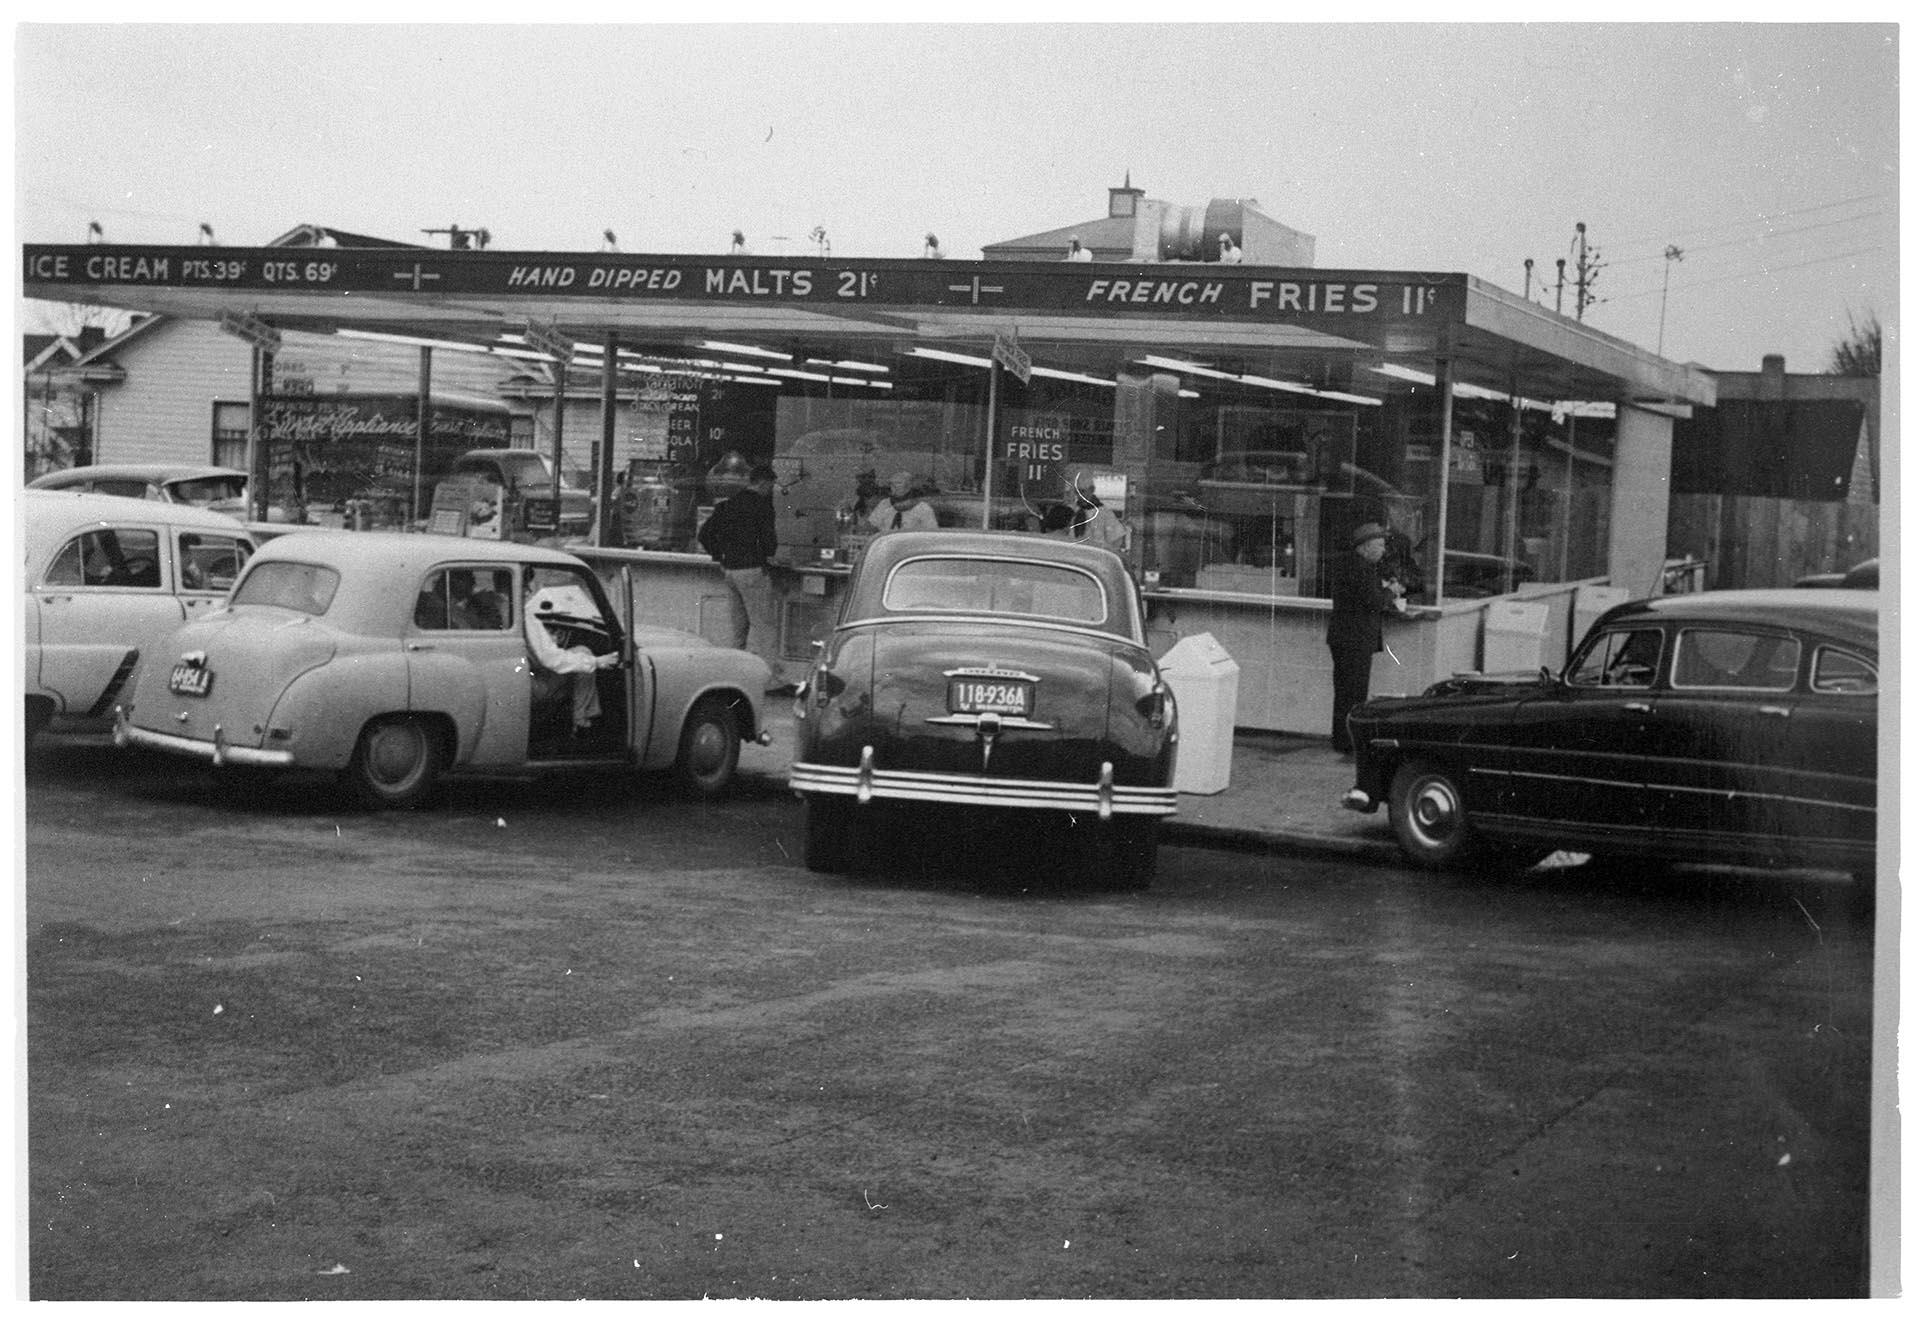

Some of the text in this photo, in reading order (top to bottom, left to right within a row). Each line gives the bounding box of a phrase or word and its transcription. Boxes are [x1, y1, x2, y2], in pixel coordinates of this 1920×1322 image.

[29, 256, 69, 279] ICE
[86, 257, 169, 280] CREAM
[508, 266, 877, 298] HAND DIPPED MALTS 21¢
[1086, 280, 1435, 314] FRENCH FRIES 11¢
[670, 418, 692, 432] EER
[1011, 426, 1061, 440] FRENCH
[670, 435, 693, 447] OLA
[1007, 442, 1063, 461] FRIES
[958, 683, 1025, 706] 118-936A
